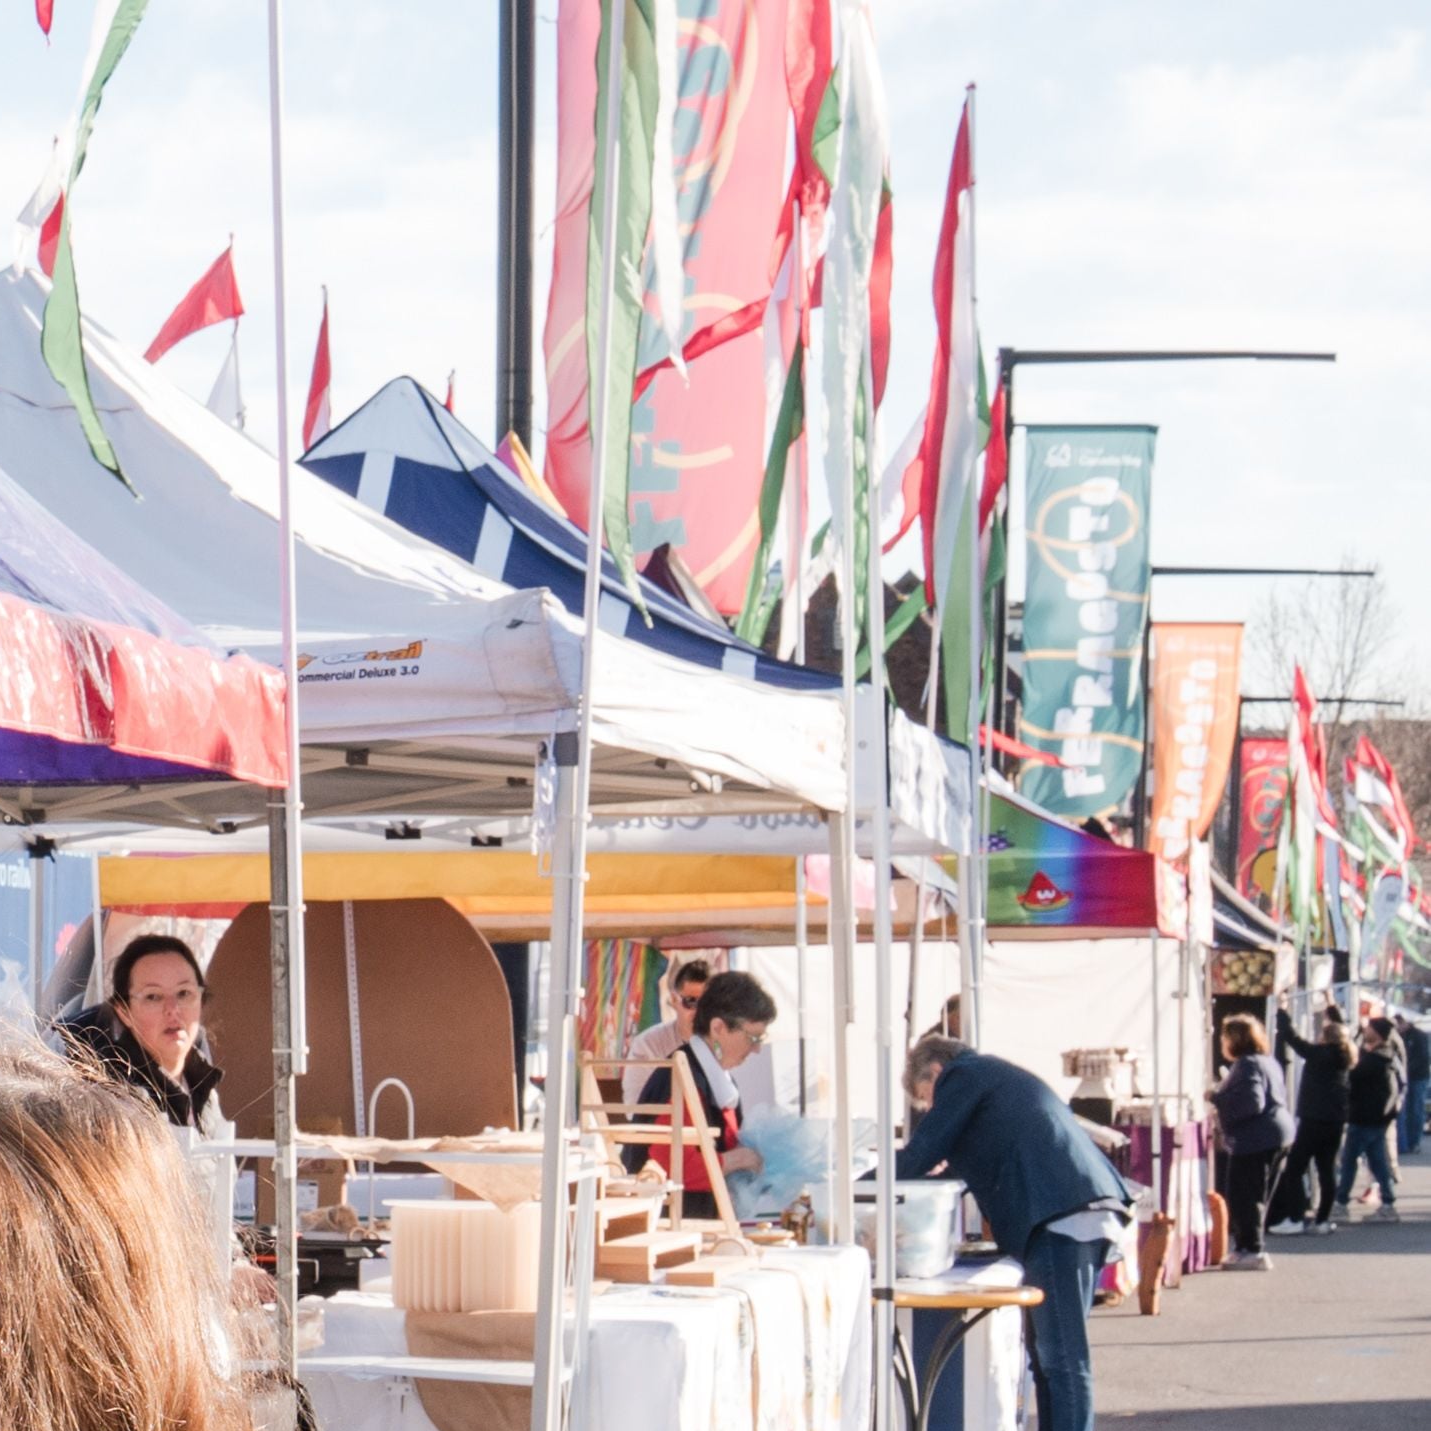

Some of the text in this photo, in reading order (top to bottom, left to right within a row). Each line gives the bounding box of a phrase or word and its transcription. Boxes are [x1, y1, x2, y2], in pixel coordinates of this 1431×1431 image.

[297, 664, 420, 684] ommercial Deluxe 3.0
